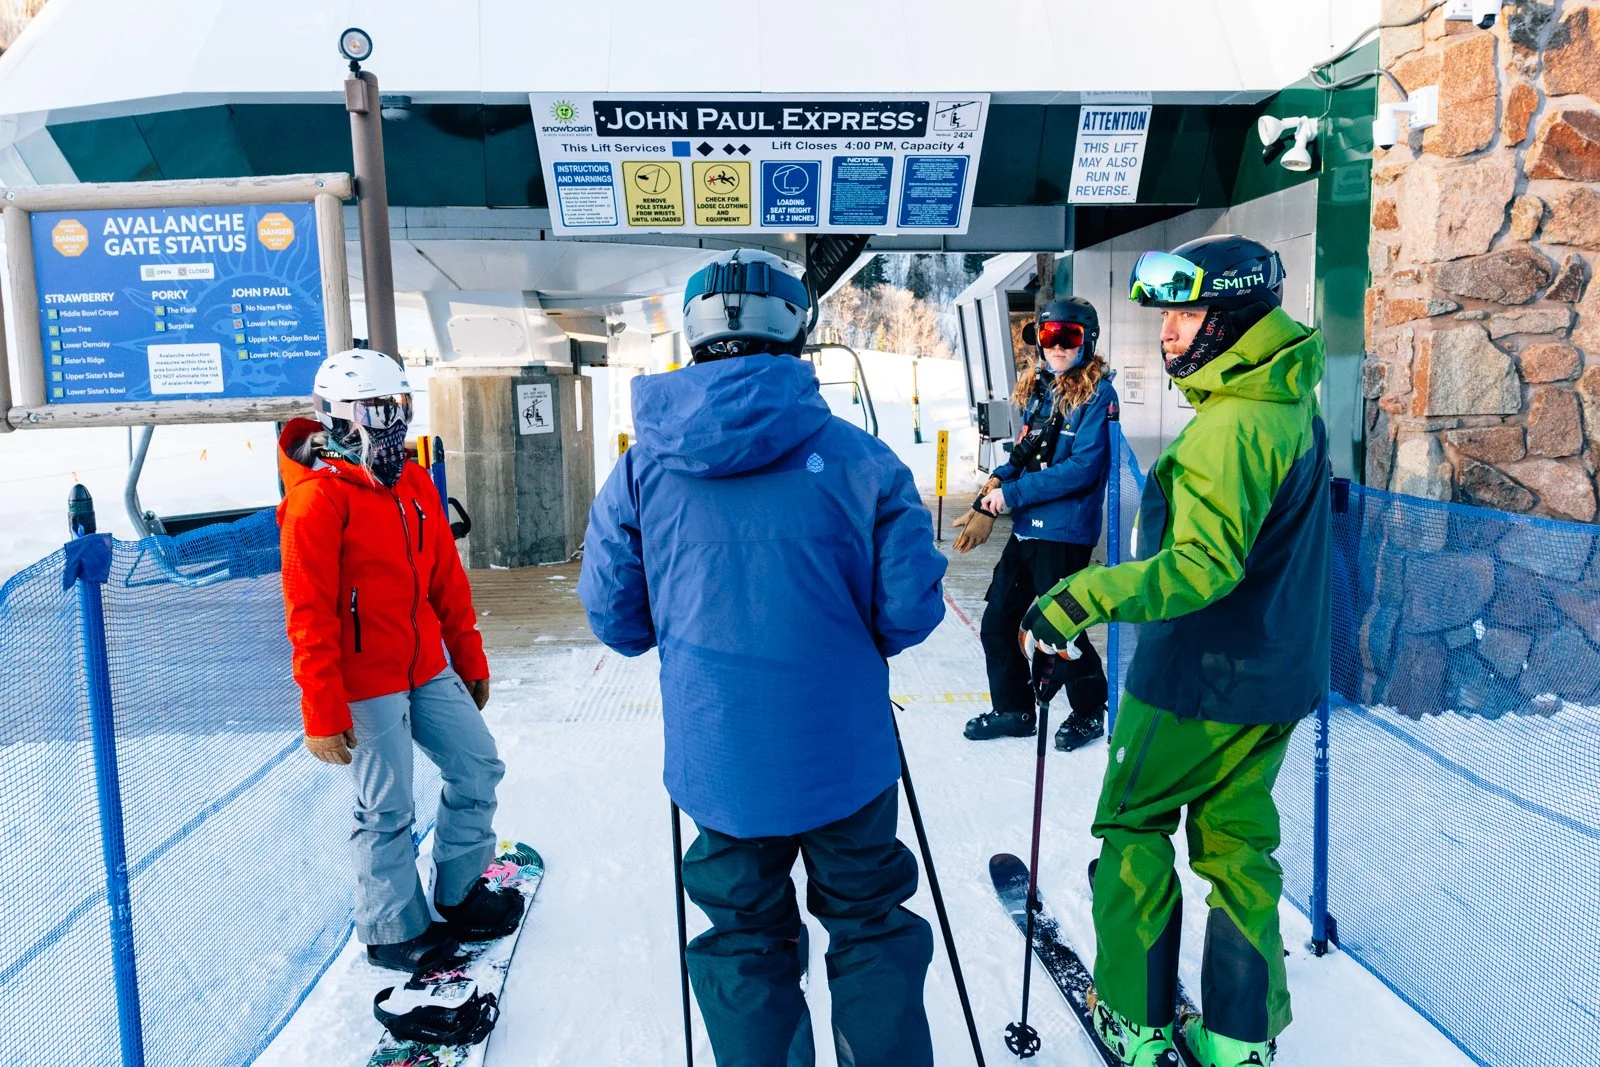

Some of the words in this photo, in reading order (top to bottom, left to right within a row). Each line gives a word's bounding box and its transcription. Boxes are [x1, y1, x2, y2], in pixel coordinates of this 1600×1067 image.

[607, 108, 688, 130] JOHN
[697, 108, 774, 130] PAUL
[782, 108, 915, 131] EXPRESS
[1082, 111, 1147, 130] ATTENTION
[562, 144, 590, 152] This
[592, 144, 611, 152] Lift
[613, 143, 666, 152] Services
[772, 142, 791, 150] Lift
[795, 142, 837, 150] Closes
[845, 141, 871, 150] 4:00
[875, 141, 896, 151] PM,
[901, 141, 954, 152] Capacity
[957, 141, 964, 150] 4
[1083, 142, 1109, 153] THIS
[1114, 142, 1138, 153] LIFT
[1078, 158, 1102, 168] MAY
[1106, 157, 1138, 168] ALSO
[1086, 172, 1110, 182] RUN
[1114, 172, 1126, 181] IN
[1076, 186, 1131, 196] REVERSE.
[103, 213, 245, 235] AVALANCHE
[260, 228, 291, 236] DANGER
[55, 235, 86, 243] DANGER
[104, 237, 160, 256] GATE
[165, 234, 247, 254] STATUS
[1212, 273, 1264, 290] SMITH
[45, 292, 115, 304] STRAWBERRY
[152, 290, 188, 300] PORKY
[232, 288, 261, 298] JOHN
[263, 287, 292, 296] PAUL
[767, 326, 784, 335] SMITH
[87, 357, 105, 365] Ridge
